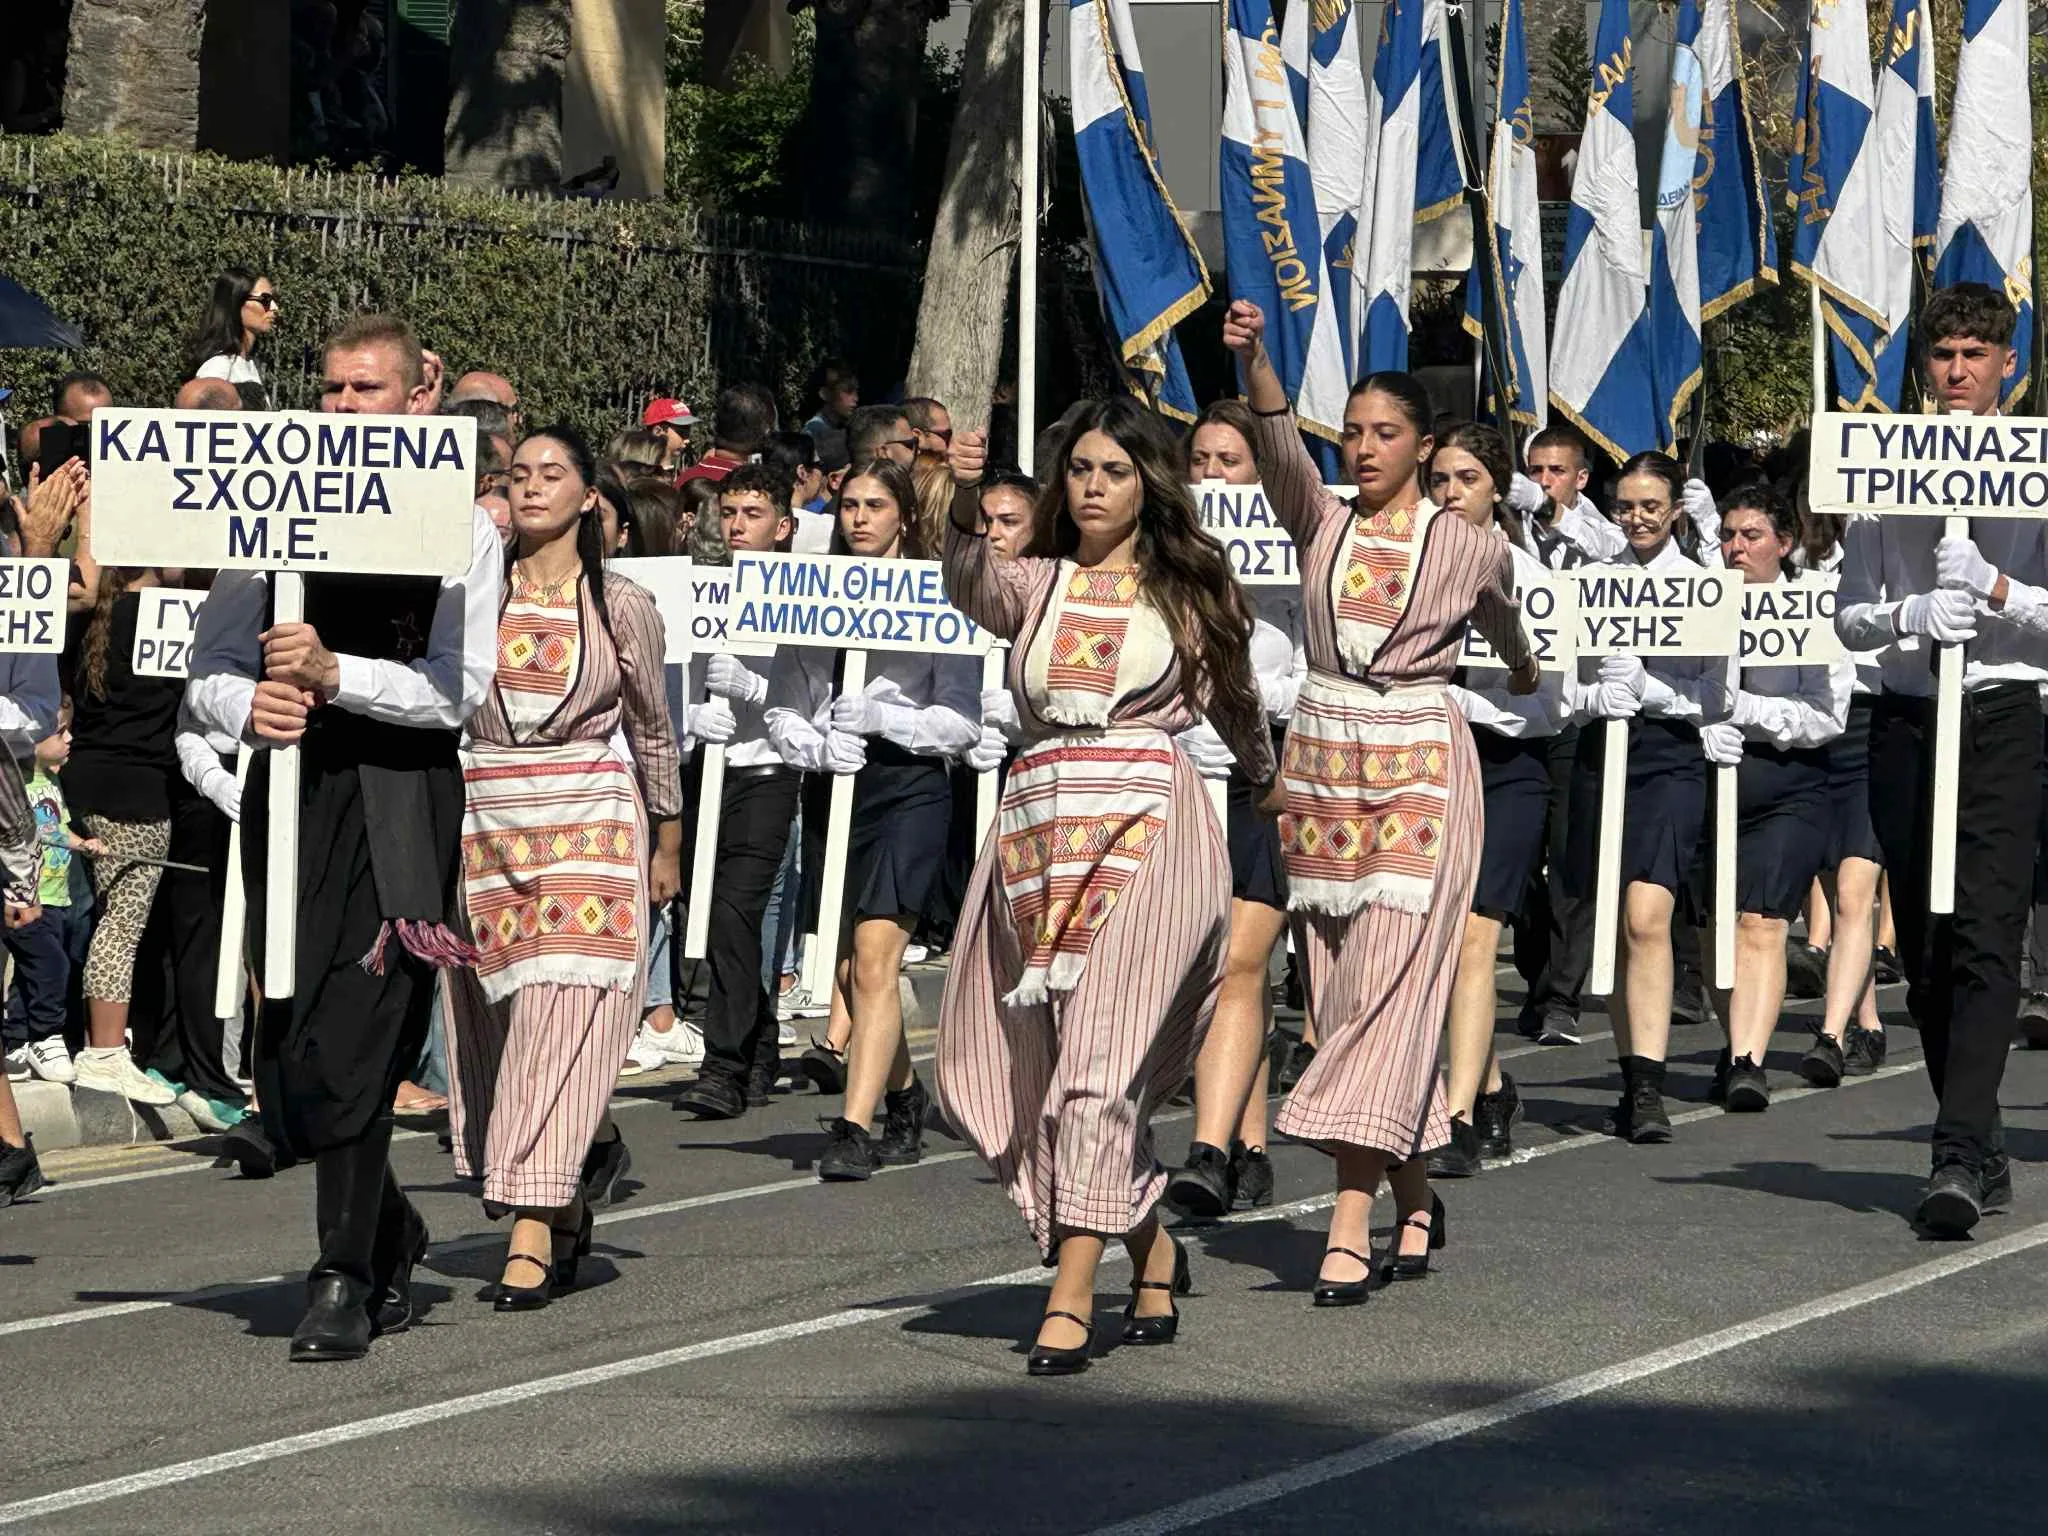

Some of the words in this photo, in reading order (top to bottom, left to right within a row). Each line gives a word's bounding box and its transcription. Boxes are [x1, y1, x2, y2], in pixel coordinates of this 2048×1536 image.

[100, 419, 464, 470] ΚΑΤΕΧΟΜΕΝΑ
[1841, 423, 2048, 463] ΓΥΜΝΑΣΙ
[172, 468, 392, 514] ΣΧΟΛΕΙΑ
[1838, 468, 2048, 507] ΤΡΙΚΩΜΟ
[229, 516, 328, 560] Μ.Ε.
[1571, 577, 1723, 607] ΜΝΑΣΙΟ
[0, 611, 53, 644] ΗΣ
[736, 602, 979, 645] ΑΜΜΟΧΩΣΤΟΥ
[1576, 616, 1683, 647] ΥΣΗΣ
